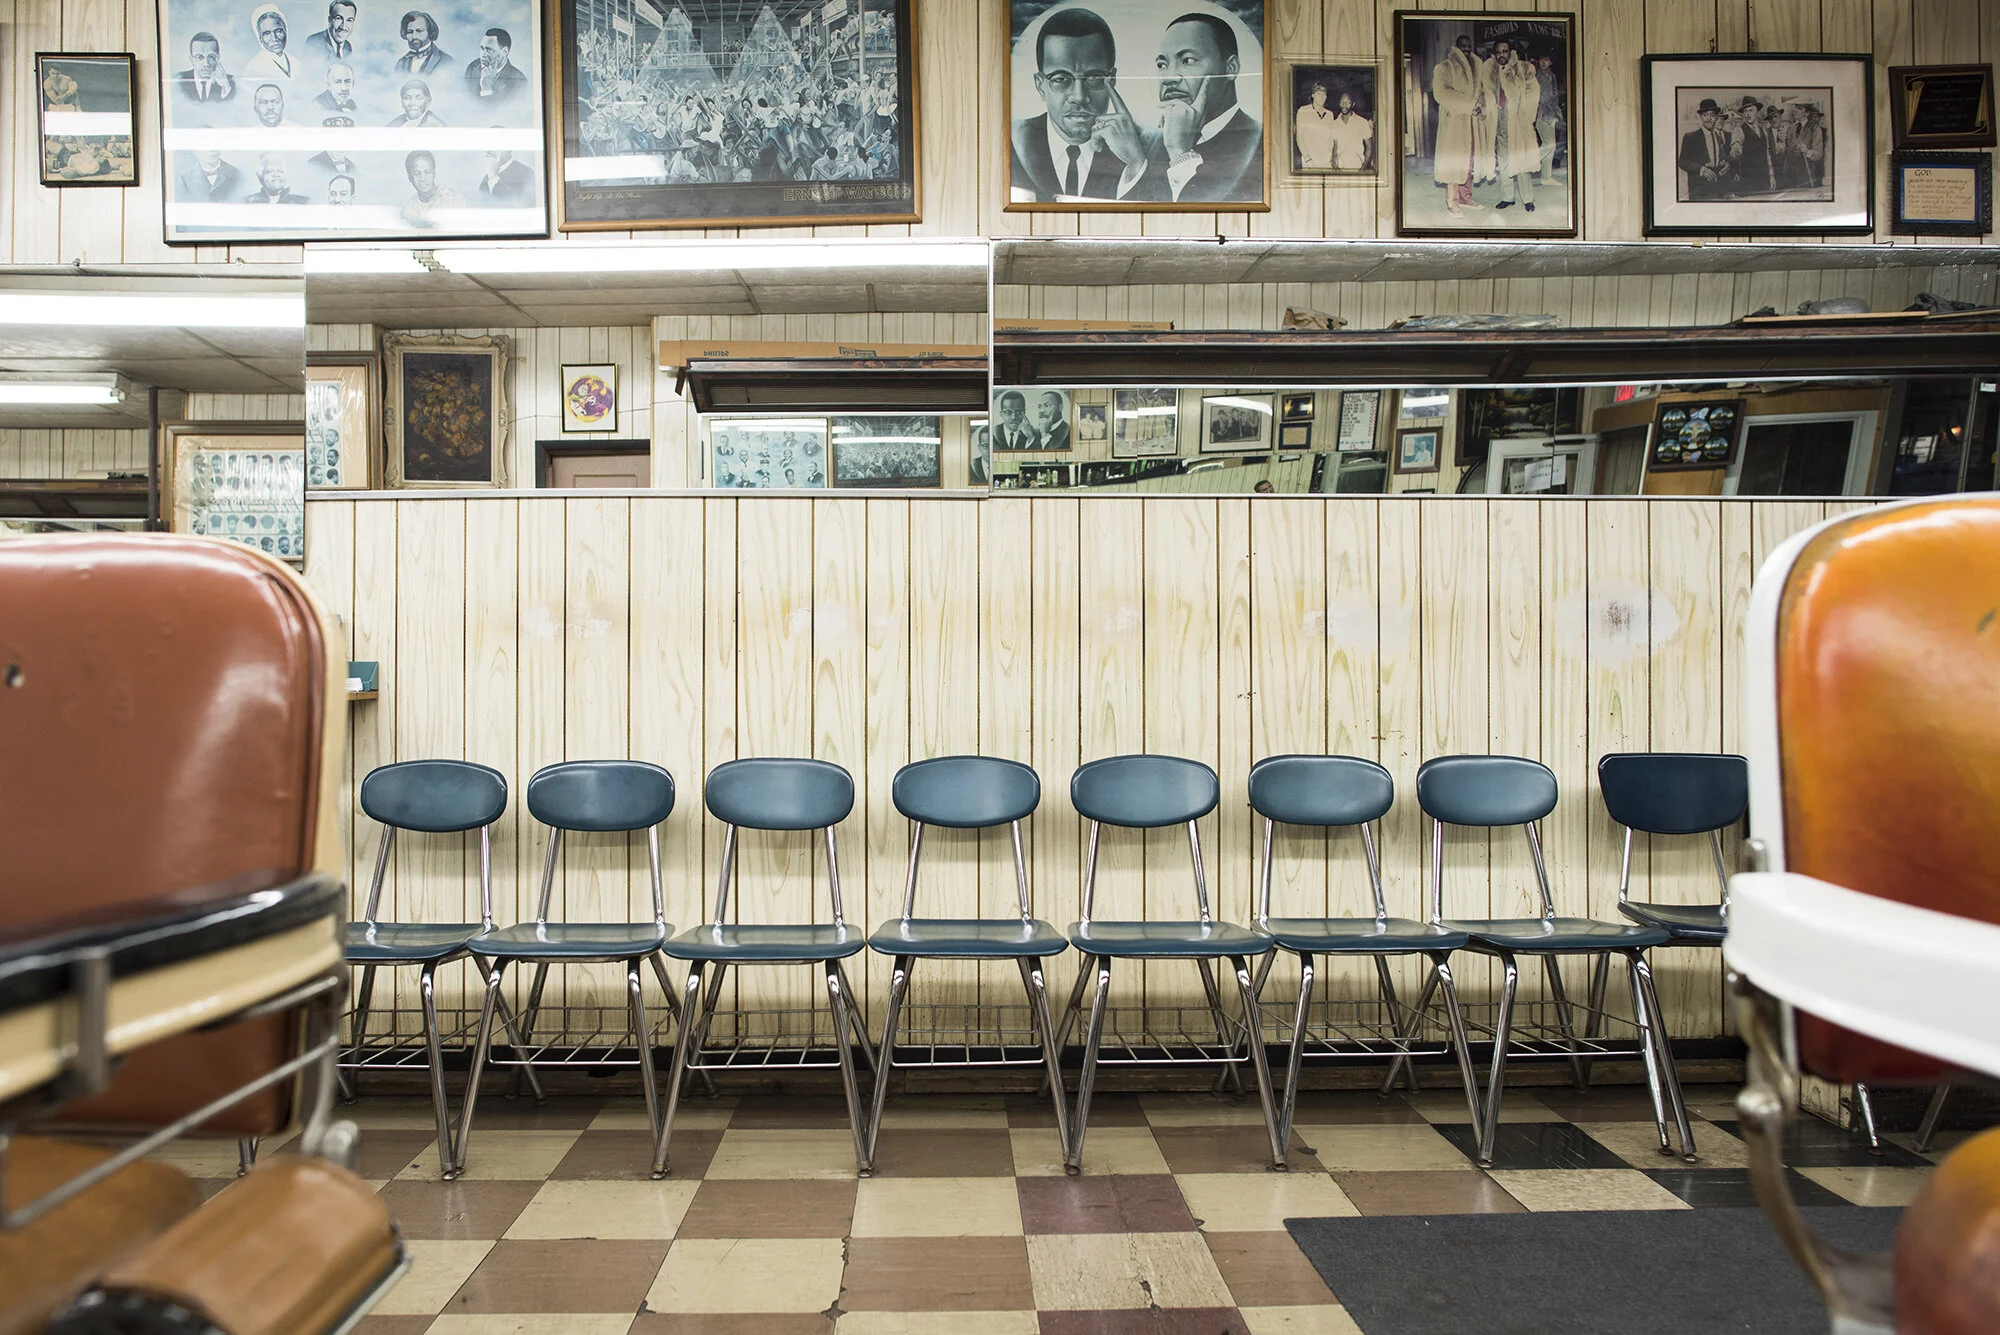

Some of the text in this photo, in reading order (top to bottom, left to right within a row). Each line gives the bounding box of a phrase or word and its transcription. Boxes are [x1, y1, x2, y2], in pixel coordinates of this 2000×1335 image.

[1484, 21, 1519, 39] FASHIONS
[783, 184, 905, 202] ERNEST WATSON
